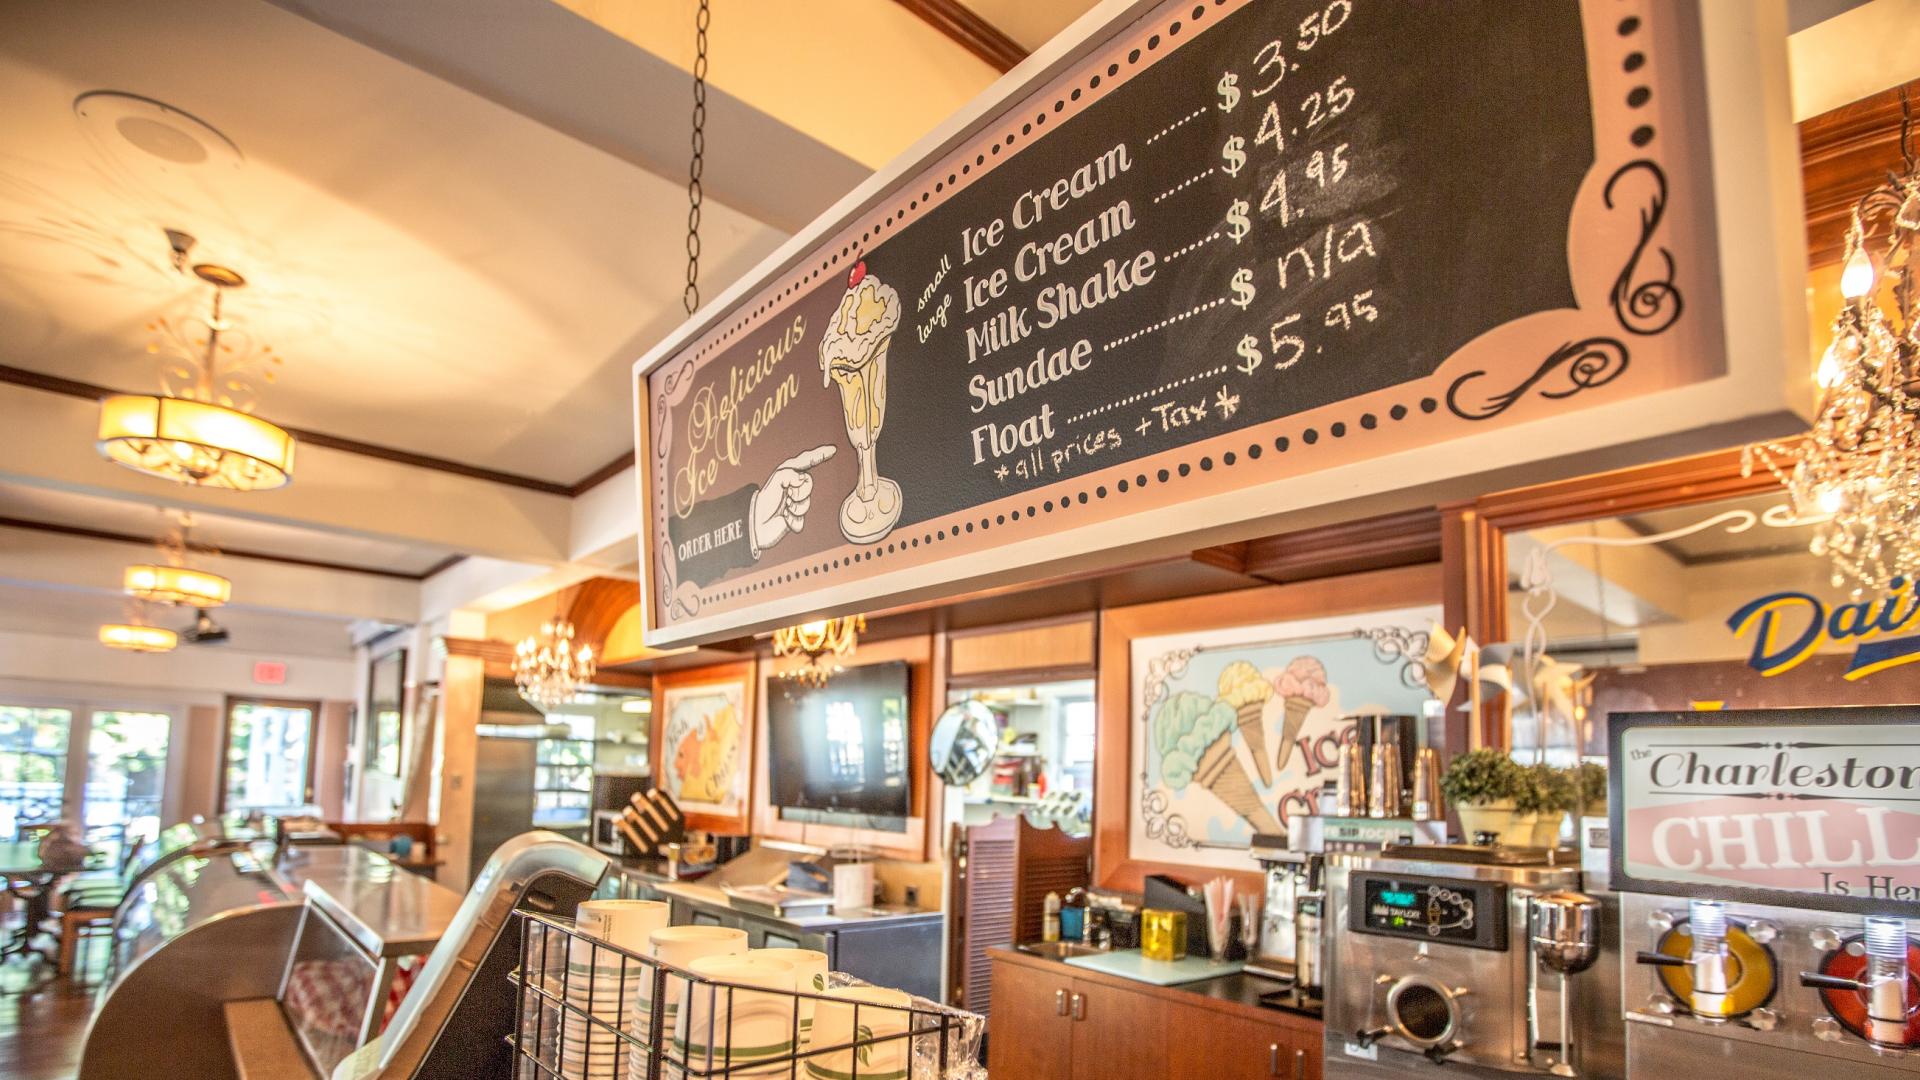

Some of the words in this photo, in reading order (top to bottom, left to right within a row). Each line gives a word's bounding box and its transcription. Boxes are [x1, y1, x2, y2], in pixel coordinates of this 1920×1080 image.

[961, 218, 1005, 265] Ice
[1012, 143, 1132, 230] Cream
[917, 254, 952, 312] small
[963, 268, 1008, 314] Ice
[1014, 200, 1136, 282] Cream
[917, 294, 952, 344] large
[966, 305, 1032, 363] Milk
[1036, 250, 1157, 329] Shake
[968, 338, 1093, 414] Sundae
[1278, 221, 1377, 289] n/a
[688, 315, 808, 452] Delicious
[674, 446, 719, 519] Ice
[715, 373, 801, 466] Cream
[970, 404, 1055, 466] Float
[1051, 427, 1123, 474] prices
[678, 531, 713, 562] ORDER
[713, 518, 744, 552] HERE
[1727, 575, 1920, 677] Dai
[1631, 748, 1652, 761] the
[1650, 750, 1920, 790] Charleston
[1652, 807, 1920, 871] CHILL
[1820, 872, 1850, 896] Is
